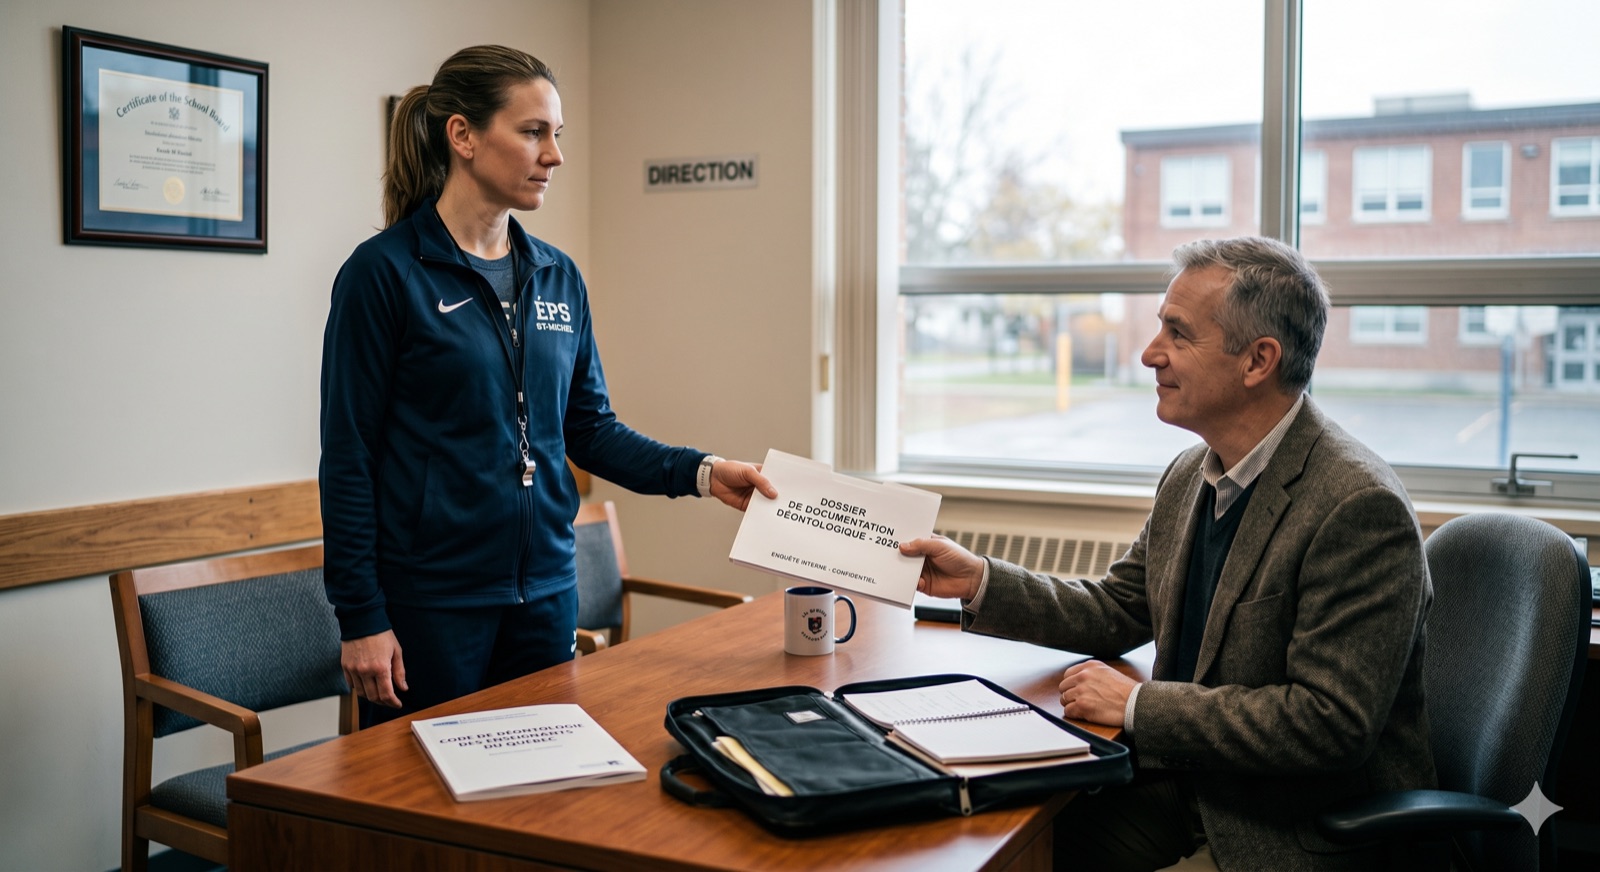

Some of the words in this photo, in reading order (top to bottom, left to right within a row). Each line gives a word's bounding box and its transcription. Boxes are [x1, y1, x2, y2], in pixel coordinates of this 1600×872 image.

[116, 94, 157, 118] Certificate
[159, 91, 168, 102] of
[169, 92, 182, 103] the
[184, 95, 210, 114] School
[209, 109, 231, 132] Board
[648, 160, 754, 186] DIRECTION
[533, 294, 572, 322] ÉPS
[536, 322, 574, 333] ST-MICHEL
[788, 500, 803, 511] DE
[805, 505, 895, 536] DOCUMENTATION
[820, 497, 867, 517] DOSSIER
[776, 508, 867, 541] DÉONTOLOGIQUE
[875, 536, 900, 549] 2026
[801, 560, 827, 572] INTERNE
[831, 568, 876, 584] CONFIDENTIEL
[440, 735, 474, 744] CODE
[486, 729, 574, 743] ENSEIGNANTS
